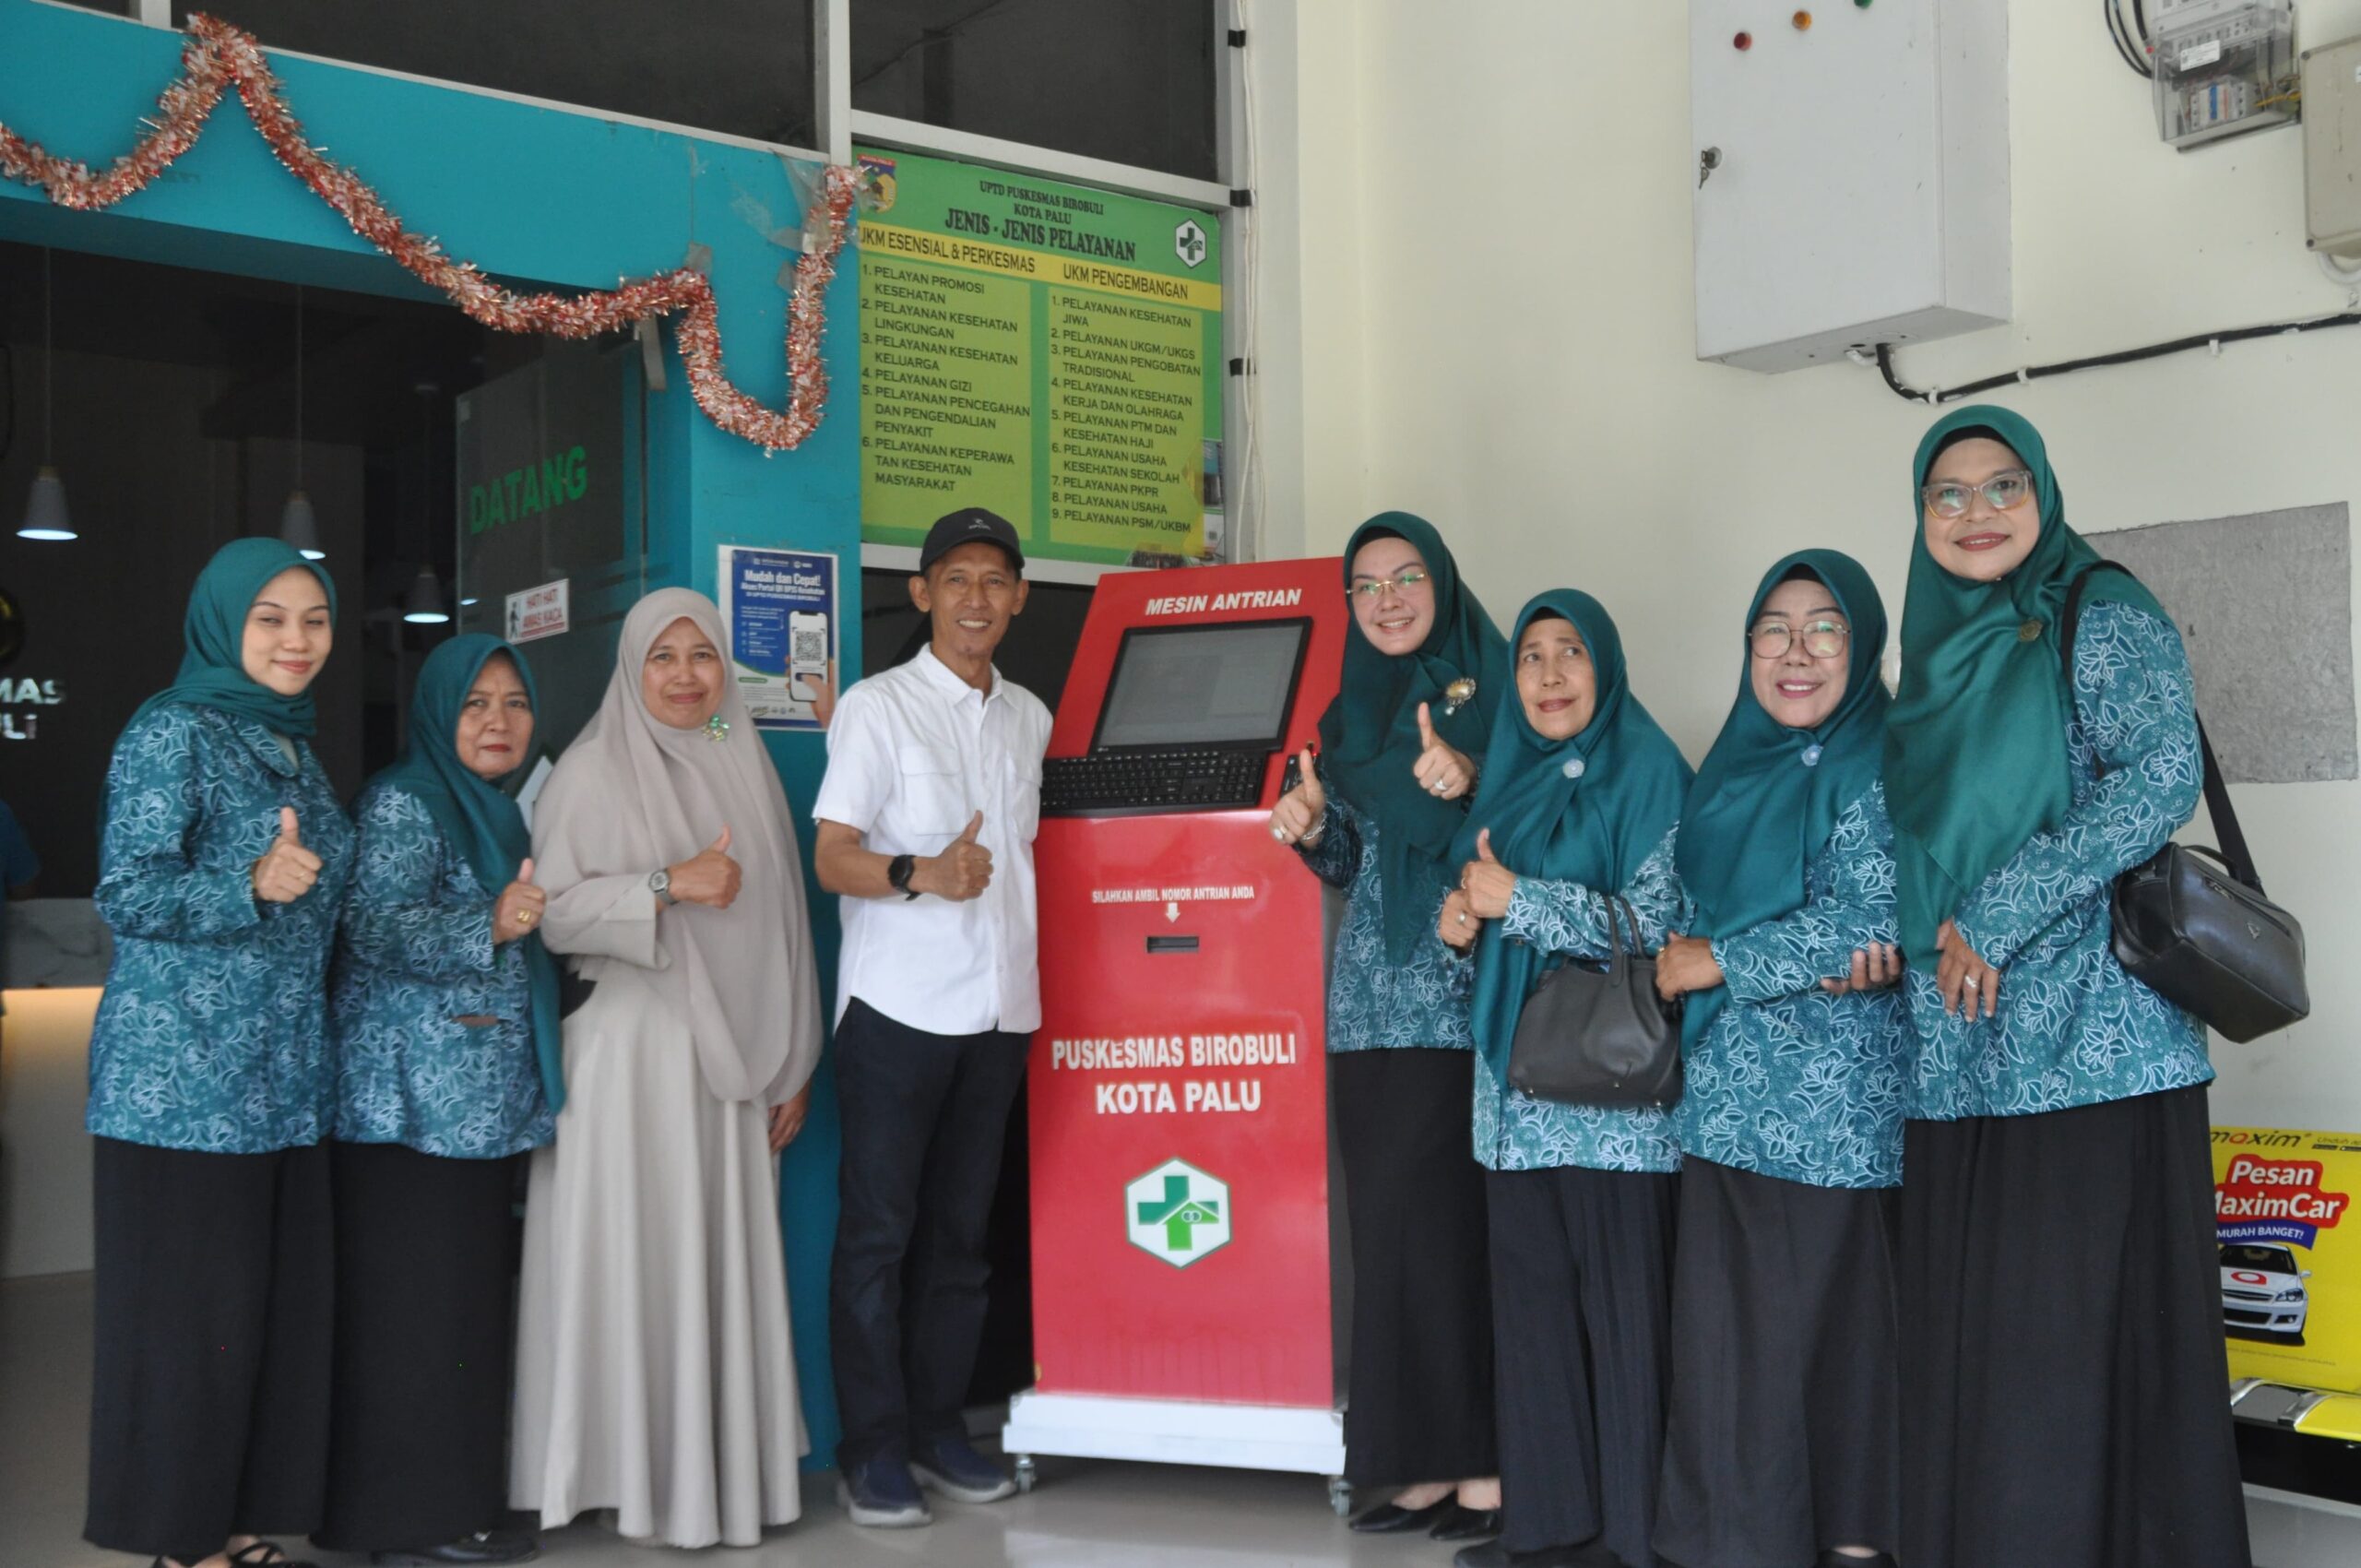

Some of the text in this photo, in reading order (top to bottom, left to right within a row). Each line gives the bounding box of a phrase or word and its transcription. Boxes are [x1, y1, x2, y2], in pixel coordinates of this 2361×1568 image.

[979, 180, 1104, 216] UPTD PUSKESMAS BIROBULI
[1014, 203, 1072, 225] KOTA PALU
[944, 208, 991, 236] JENIS
[1002, 219, 1045, 245] JENIS
[1050, 227, 1136, 262] PELAYANAN
[888, 232, 949, 259] ESENSIAL
[951, 244, 959, 259] &
[962, 244, 1035, 273] PERKESMAS
[874, 266, 929, 285] PELAYAN
[931, 275, 984, 294] PROMOSI
[1063, 263, 1188, 300] UKM PENGEMBANGAN
[874, 283, 945, 304] KESEHATAN
[875, 300, 947, 322] PELAYANAN
[949, 312, 1018, 332] KESEHATAN
[1062, 296, 1127, 317] PELAYANAN
[1129, 308, 1192, 327] KESEHATAN
[1062, 314, 1089, 327] JIWA
[874, 317, 955, 339] LINGKUNGAN
[1062, 329, 1128, 349] PELAYANAN
[874, 352, 940, 371] KELUARGA
[875, 334, 947, 355] PELAYANAN
[949, 346, 1018, 365] KESEHATAN
[1062, 346, 1128, 366] PELAYANAN
[1131, 356, 1201, 376] PENGOBATAN
[875, 368, 947, 389] PELAYANAN
[949, 379, 972, 392] GIZI
[1062, 362, 1135, 383] TRADISIONAL
[875, 386, 947, 406] PELAYANAN
[950, 396, 1030, 416] PENCEGAHAN
[1063, 378, 1128, 398] PELAYANAN
[1131, 388, 1192, 407] KESEHATAN
[875, 403, 996, 429] DAN PENGENDALIAN
[1063, 395, 1184, 422] KERJA DAN OLAHRAGA
[875, 421, 933, 438] PENYAKIT
[1063, 410, 1128, 431] PELAYANAN
[1131, 420, 1153, 433] PTM
[1155, 422, 1177, 436] DAN
[1063, 427, 1154, 449] KESEHATAN HAJI
[875, 438, 947, 457] PELAYANAN
[950, 447, 1014, 465] KEPERAWA
[1063, 444, 1129, 462] PELAYANAN
[1131, 453, 1168, 467] USAHA
[875, 455, 972, 476] TAN KESEHATAN
[1063, 460, 1180, 484] KESEHATAN SEKOLAH
[470, 445, 587, 535] DATANG
[874, 472, 955, 492] MASYARAKAT
[1062, 476, 1128, 494] PELAYANAN
[1130, 484, 1159, 498] PKPR
[1063, 493, 1130, 510] PELAYANAN
[1131, 502, 1168, 515] USAHA
[1064, 510, 1130, 527] PELAYANAN
[744, 569, 774, 583] Mudah
[776, 572, 792, 585] dan
[1145, 588, 1302, 616] MESIN ANTRIAN
[1092, 885, 1255, 904] SILAHKAN AMBIL NOMOR ANTRIAN ANDA
[1050, 1033, 1297, 1070] PUSKESMAS BIROBULI
[1095, 1080, 1261, 1114] KOTA PALU
[2230, 1160, 2315, 1185] Pesan
[2216, 1226, 2305, 1240] MURAH BANGET!
